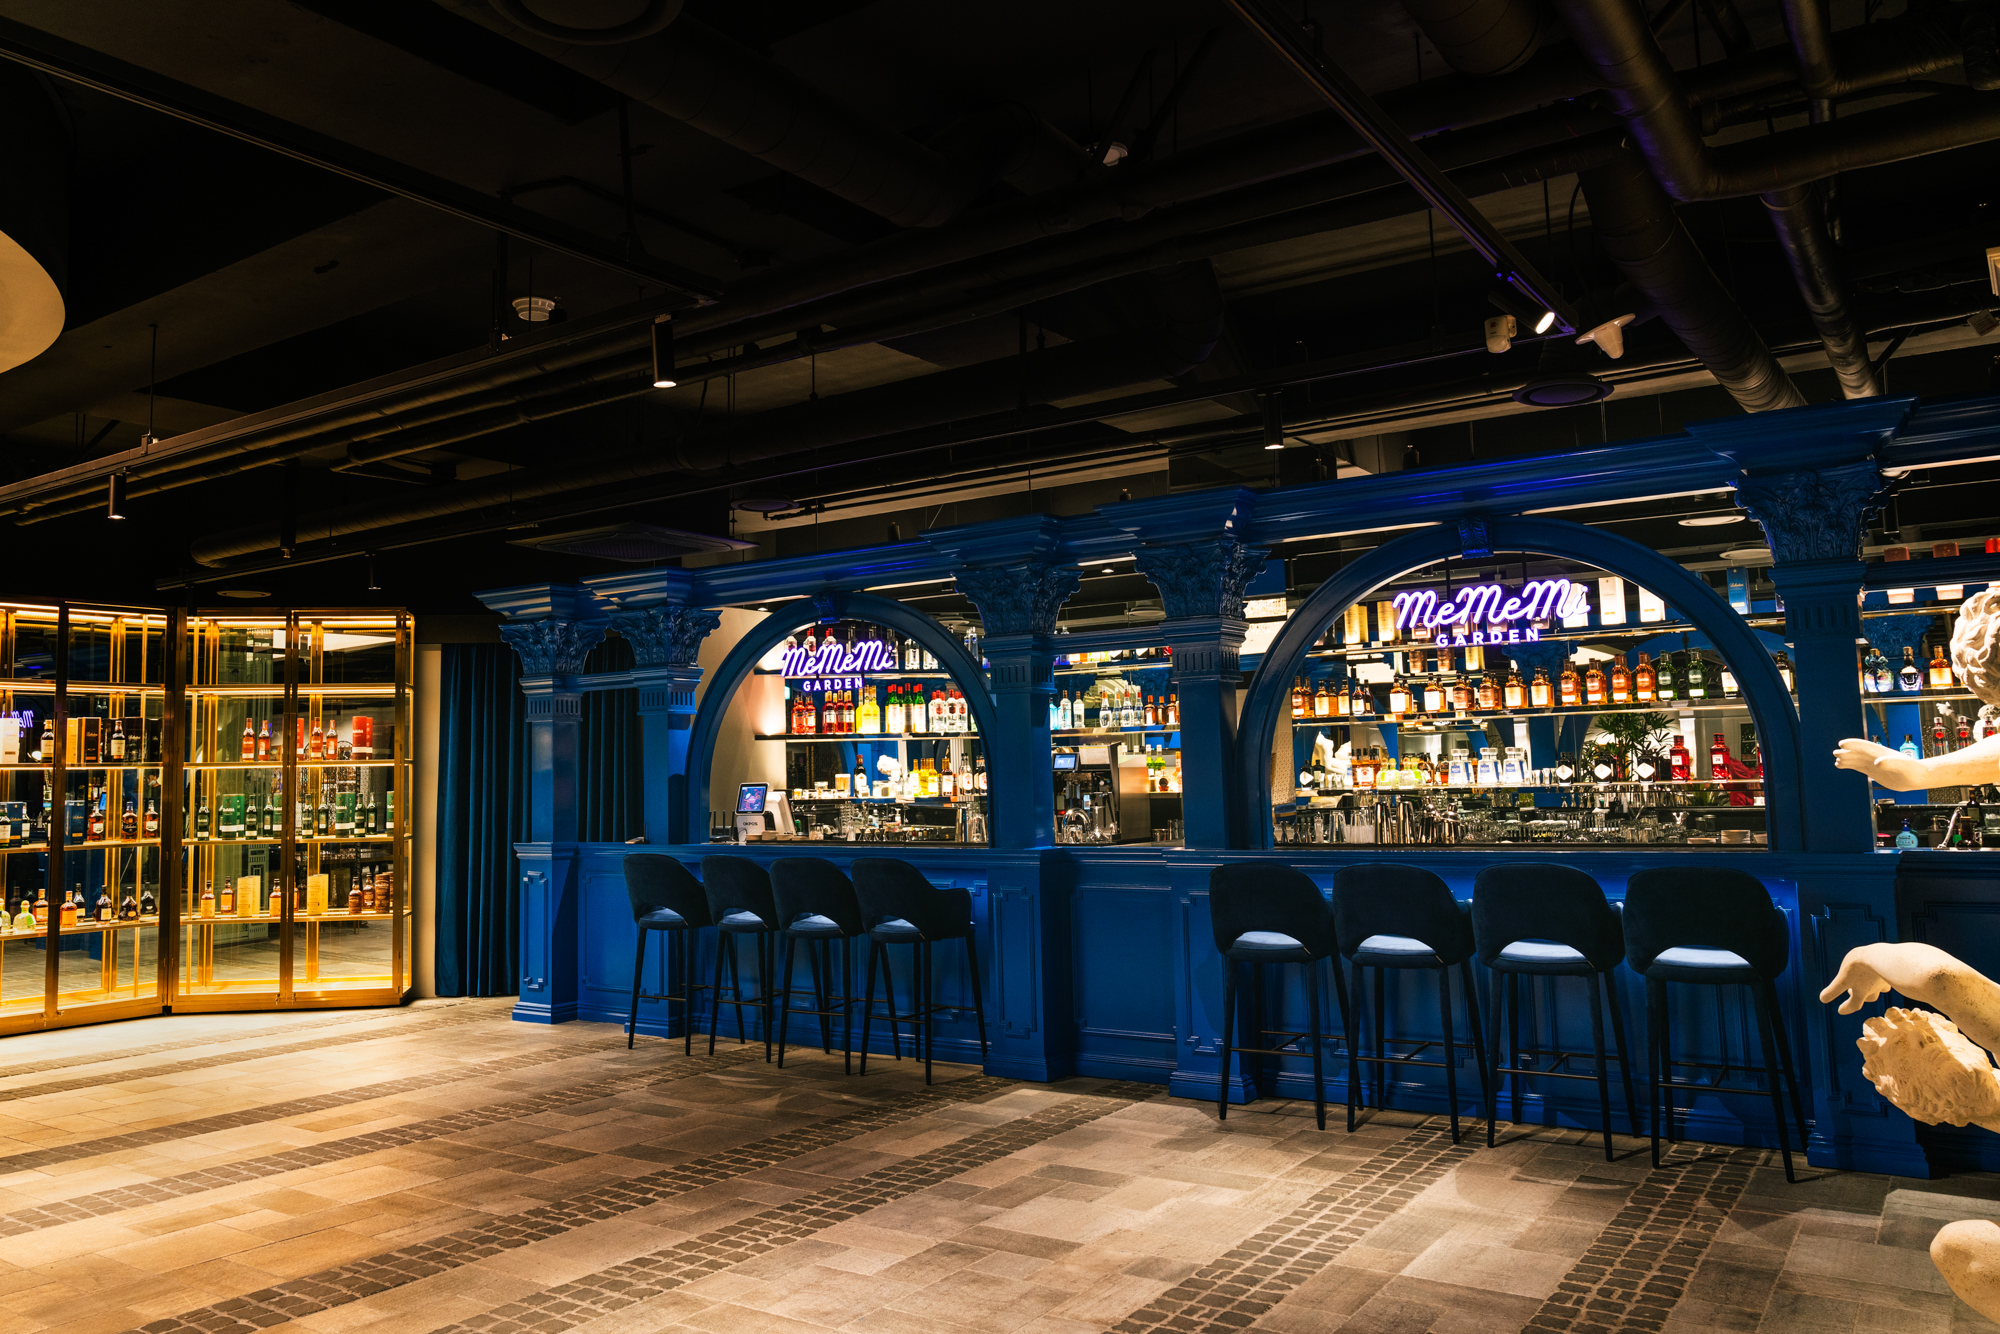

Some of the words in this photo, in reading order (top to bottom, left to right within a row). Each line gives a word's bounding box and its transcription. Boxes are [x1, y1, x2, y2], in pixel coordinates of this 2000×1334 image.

[1393, 579, 1591, 629] MeMeMi
[1436, 628, 1539, 648] GARDEN
[781, 640, 894, 677] MeMeMi
[803, 677, 863, 692] GARDEN
